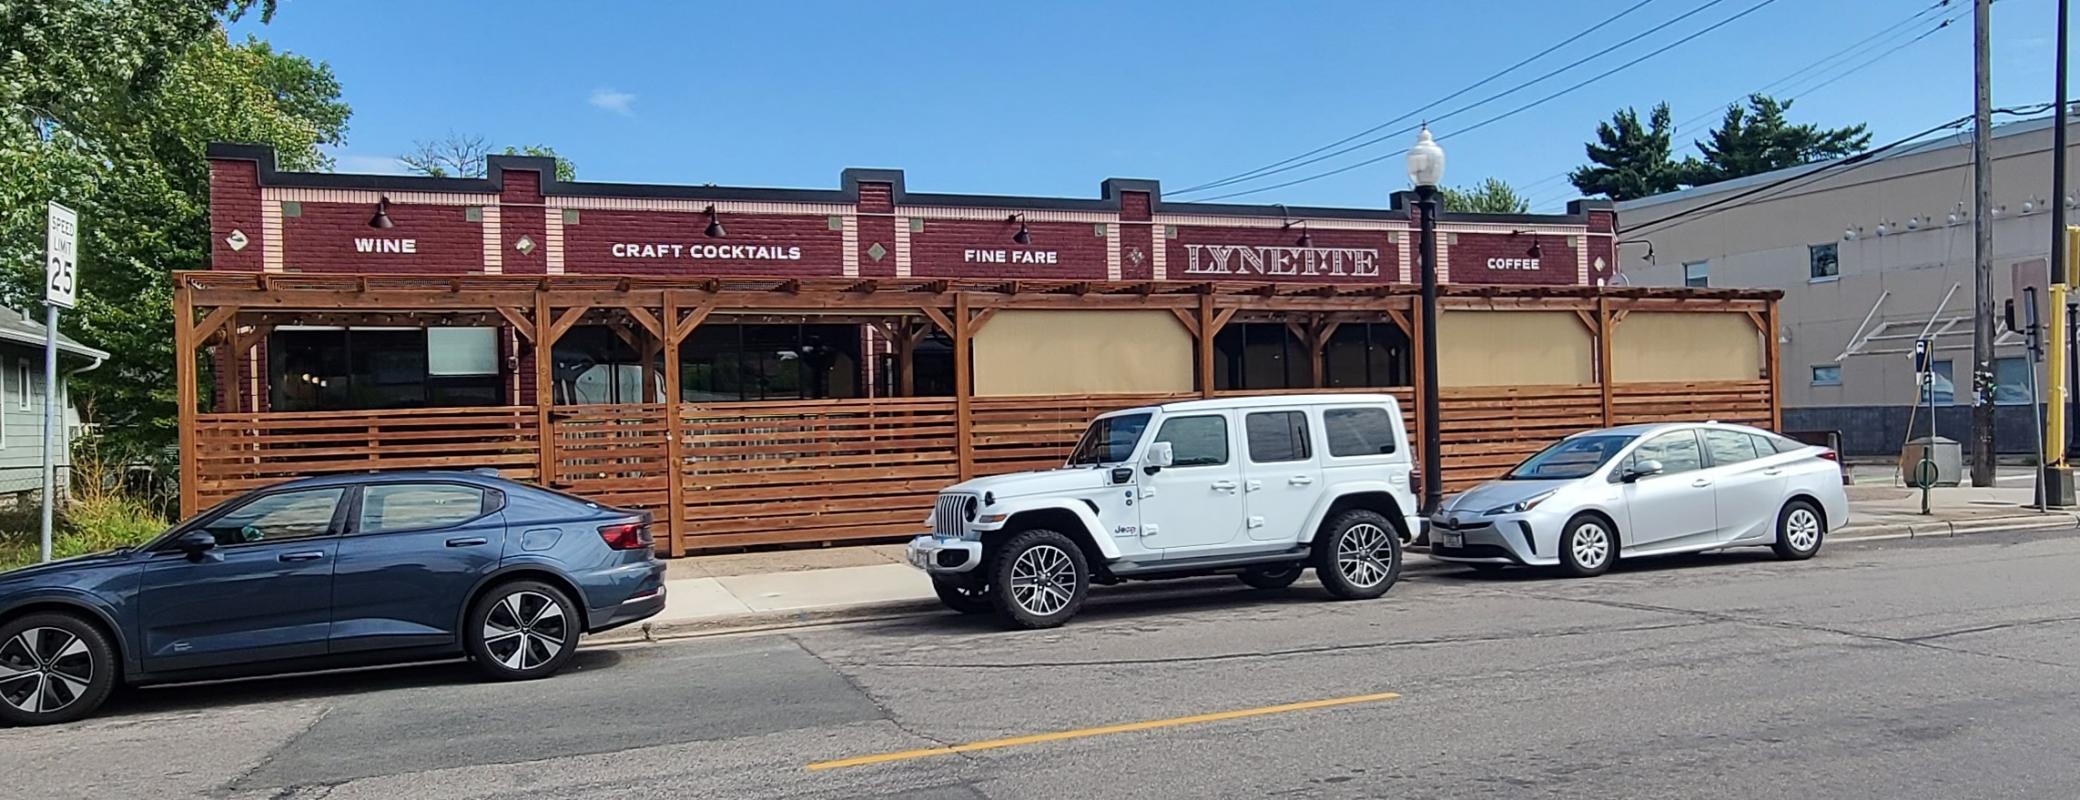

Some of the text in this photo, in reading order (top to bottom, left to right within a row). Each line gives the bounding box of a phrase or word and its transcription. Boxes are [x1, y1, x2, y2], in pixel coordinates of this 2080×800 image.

[52, 215, 75, 237] SPEED
[53, 236, 72, 257] LIMIT
[354, 238, 417, 253] WINE
[612, 243, 801, 260] CRAFT COCKTAILS
[964, 249, 1058, 264] FINE FARE
[1184, 244, 1379, 277] LYNETTE
[1487, 257, 1540, 270] COFFEE
[51, 257, 73, 295] 25
